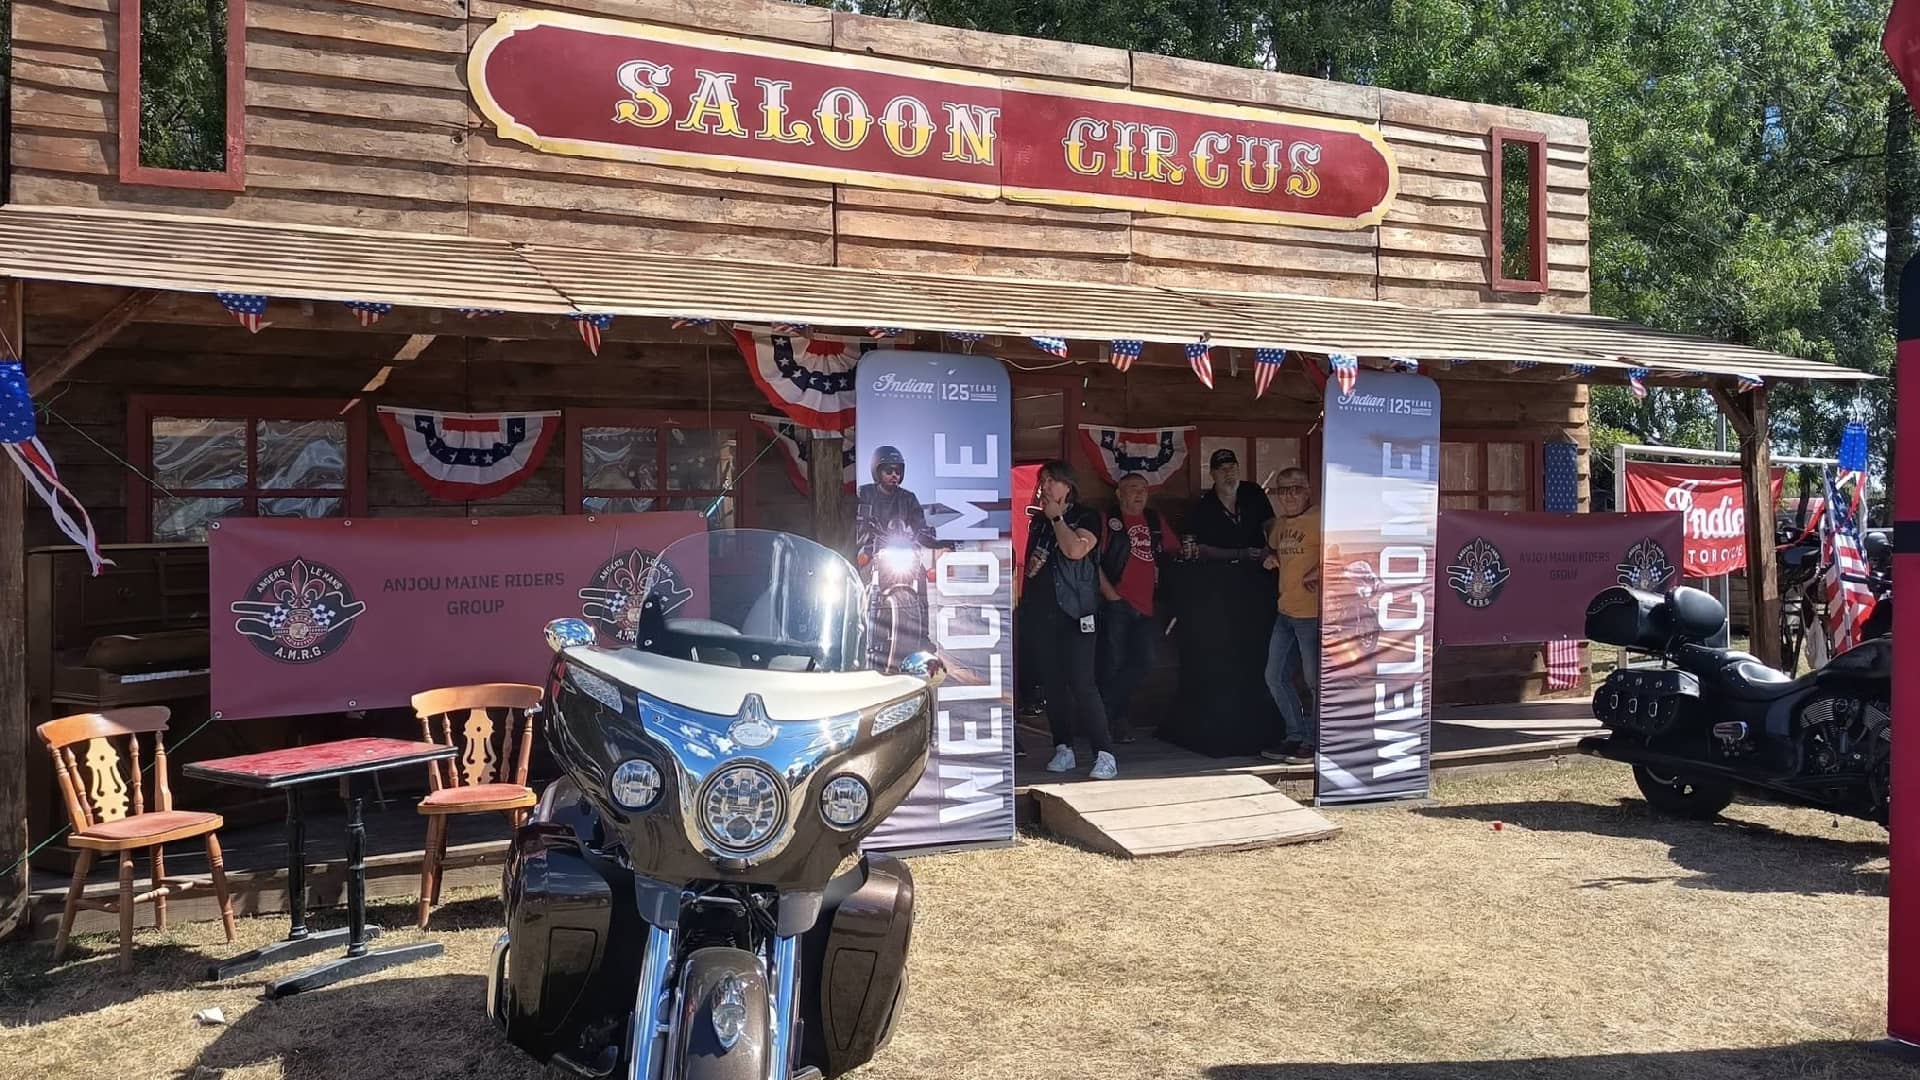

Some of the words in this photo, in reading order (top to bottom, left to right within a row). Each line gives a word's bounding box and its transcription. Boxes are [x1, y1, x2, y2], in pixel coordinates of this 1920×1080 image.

[612, 59, 1001, 167] SALOON
[1061, 116, 1321, 198] CIRCUS
[872, 373, 935, 394] Indian
[942, 383, 969, 401] 125
[969, 384, 997, 393] YEARS
[1337, 390, 1385, 407] Indian
[1389, 398, 1411, 414] 125
[256, 568, 286, 593] ANGERS
[310, 566, 323, 576] LE
[322, 572, 343, 590] MANS
[383, 577, 441, 593] ANJOU
[445, 575, 499, 590] MAINE
[504, 572, 565, 588] RIDERS
[447, 600, 505, 616] GROUP
[1373, 441, 1431, 779] WELCOME
[934, 432, 1004, 824] WELCOME
[274, 646, 327, 660] A.M.R.G.
